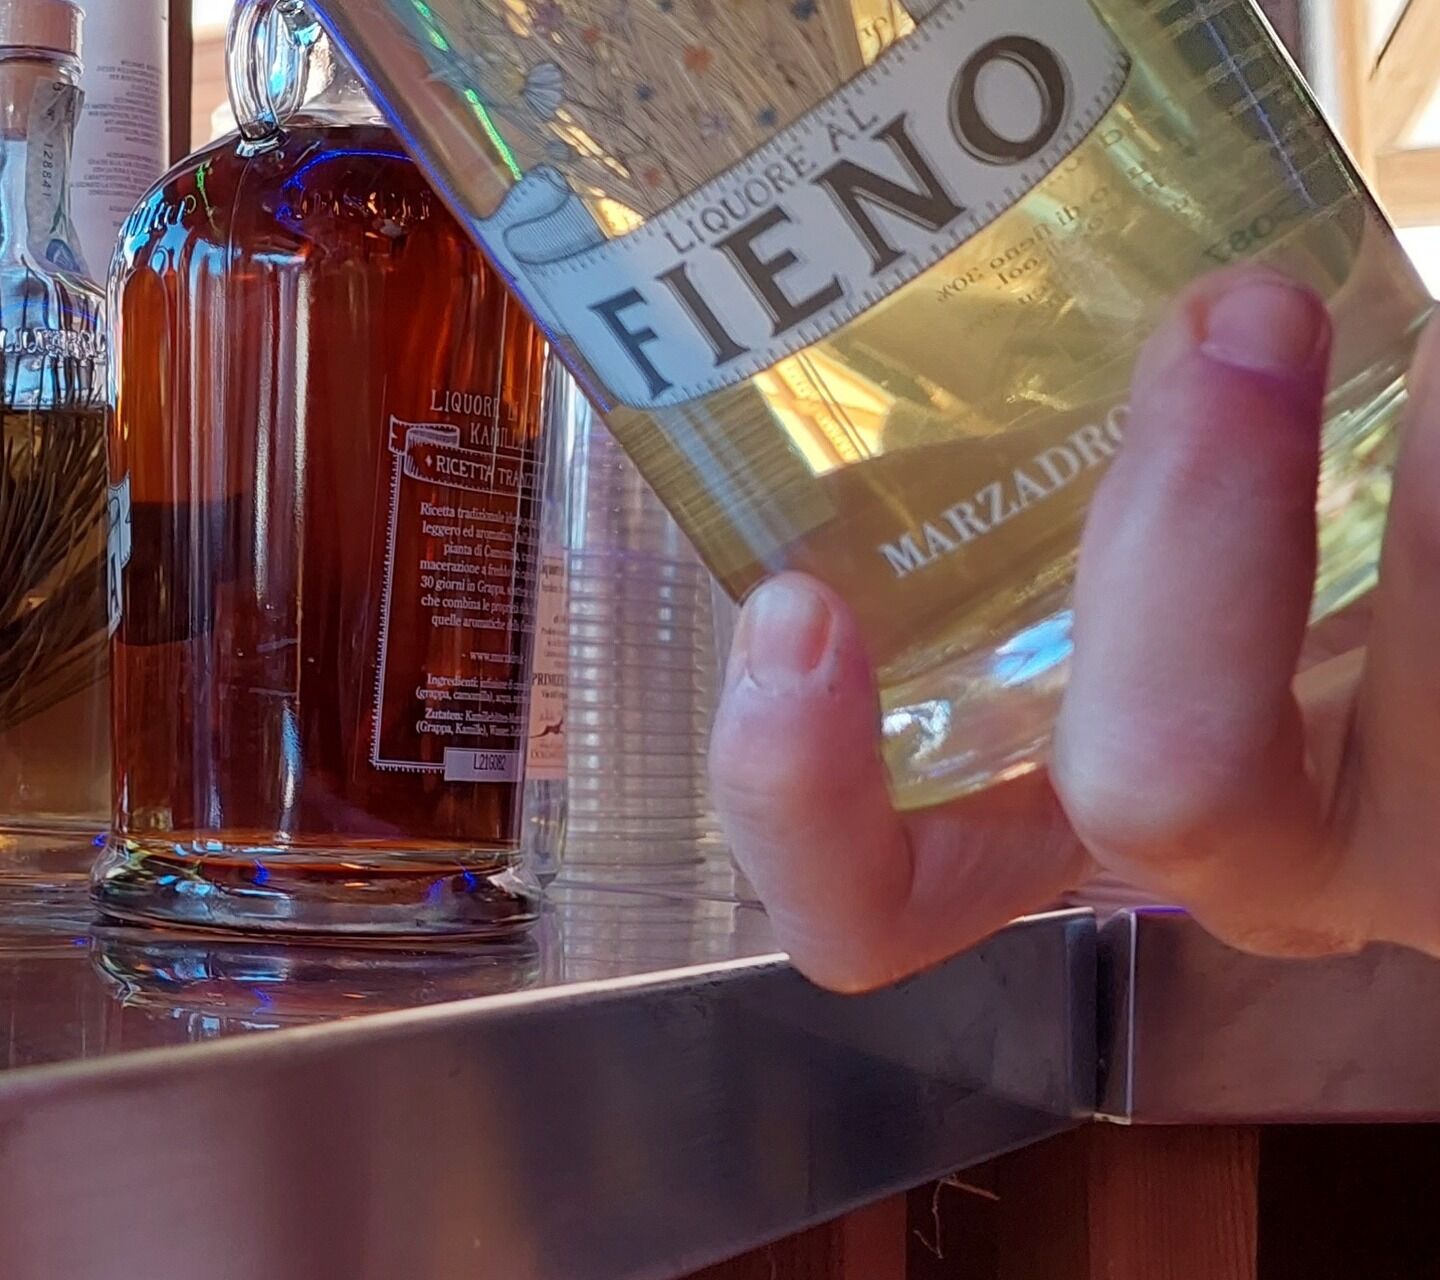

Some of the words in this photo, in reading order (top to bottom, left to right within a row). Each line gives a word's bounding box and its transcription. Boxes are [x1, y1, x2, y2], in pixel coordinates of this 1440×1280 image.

[664, 145, 816, 253] LIQUORE
[828, 108, 878, 153] AL
[587, 36, 1072, 400] FIENO
[436, 455, 493, 482] RICETTA
[420, 502, 455, 518] Ricetta
[422, 520, 460, 536] leggero
[463, 525, 474, 537] ed
[474, 544, 482, 557] di
[420, 559, 480, 575] macerazione
[420, 575, 434, 589] 30
[435, 577, 466, 591] giorni
[467, 579, 475, 592] in
[421, 594, 441, 607] che
[442, 597, 481, 611] combina
[483, 599, 490, 612] le
[431, 614, 461, 627] quelle
